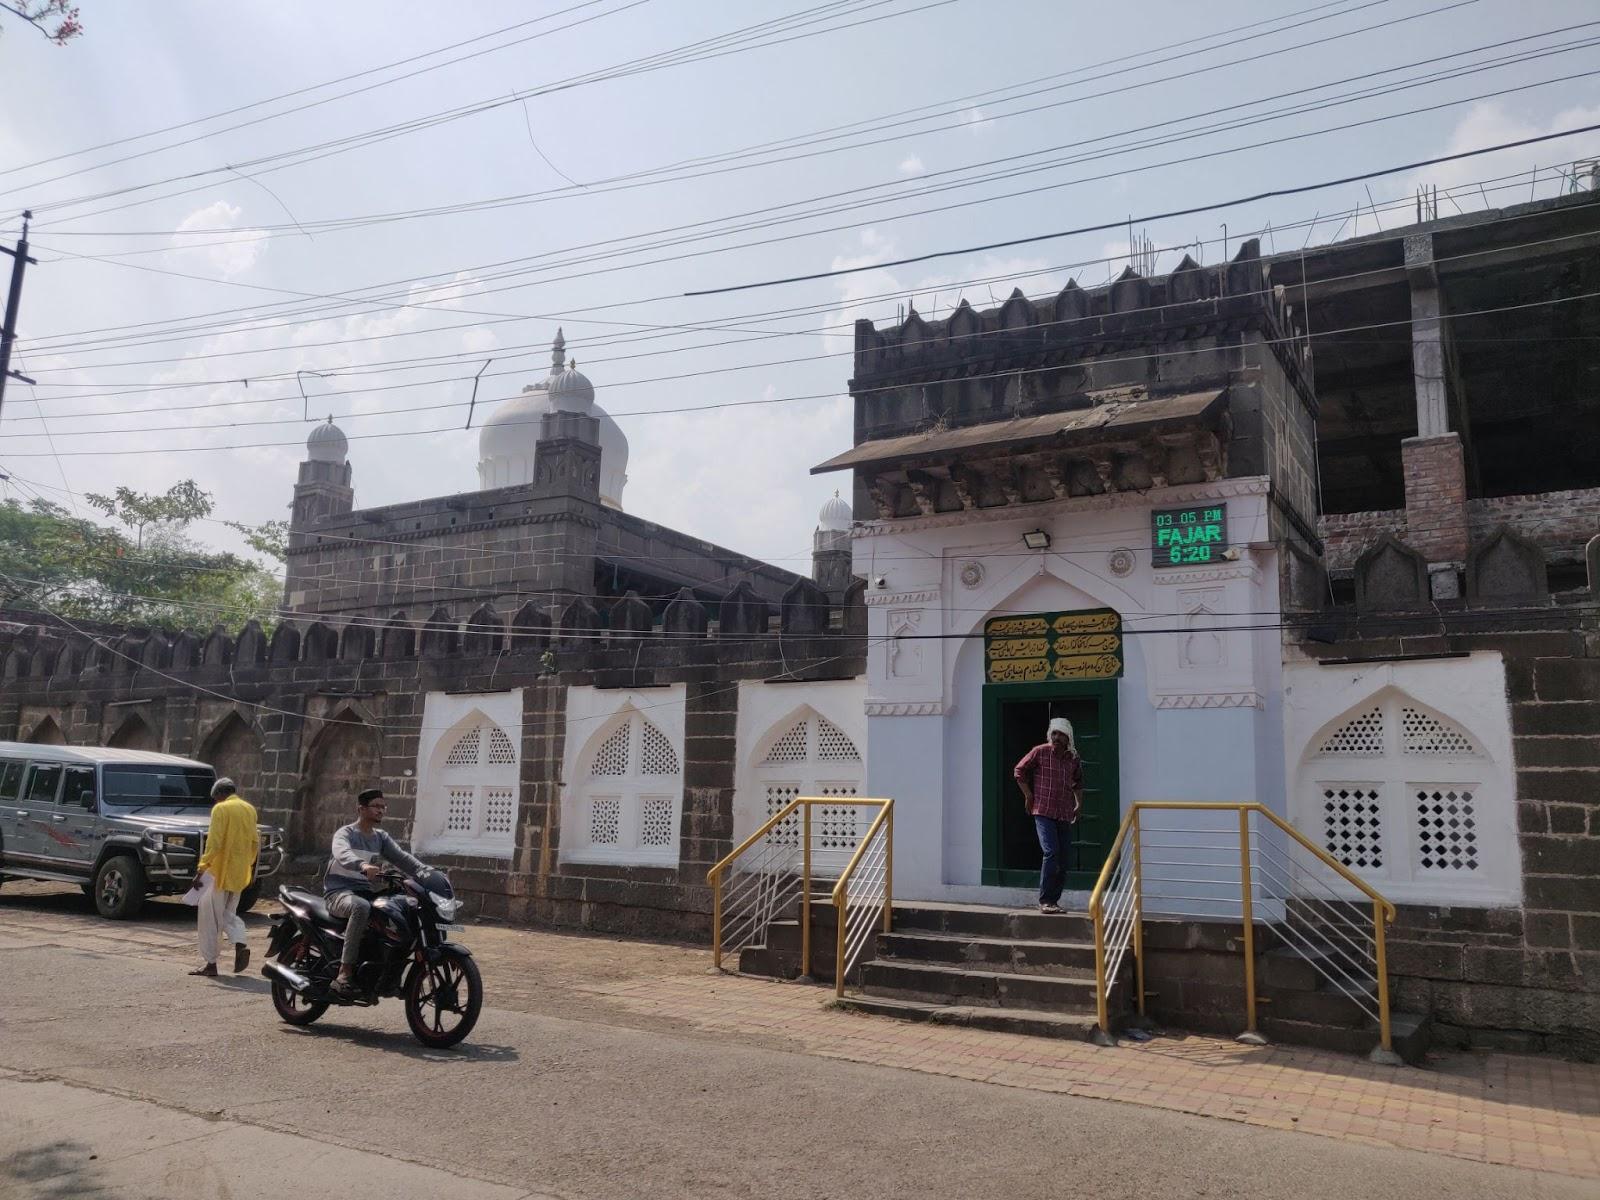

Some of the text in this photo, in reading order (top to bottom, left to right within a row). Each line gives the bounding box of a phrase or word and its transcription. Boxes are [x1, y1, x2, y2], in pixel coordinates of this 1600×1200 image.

[1157, 509, 1222, 527] 03 05 PM
[1157, 525, 1221, 546] FAJAR
